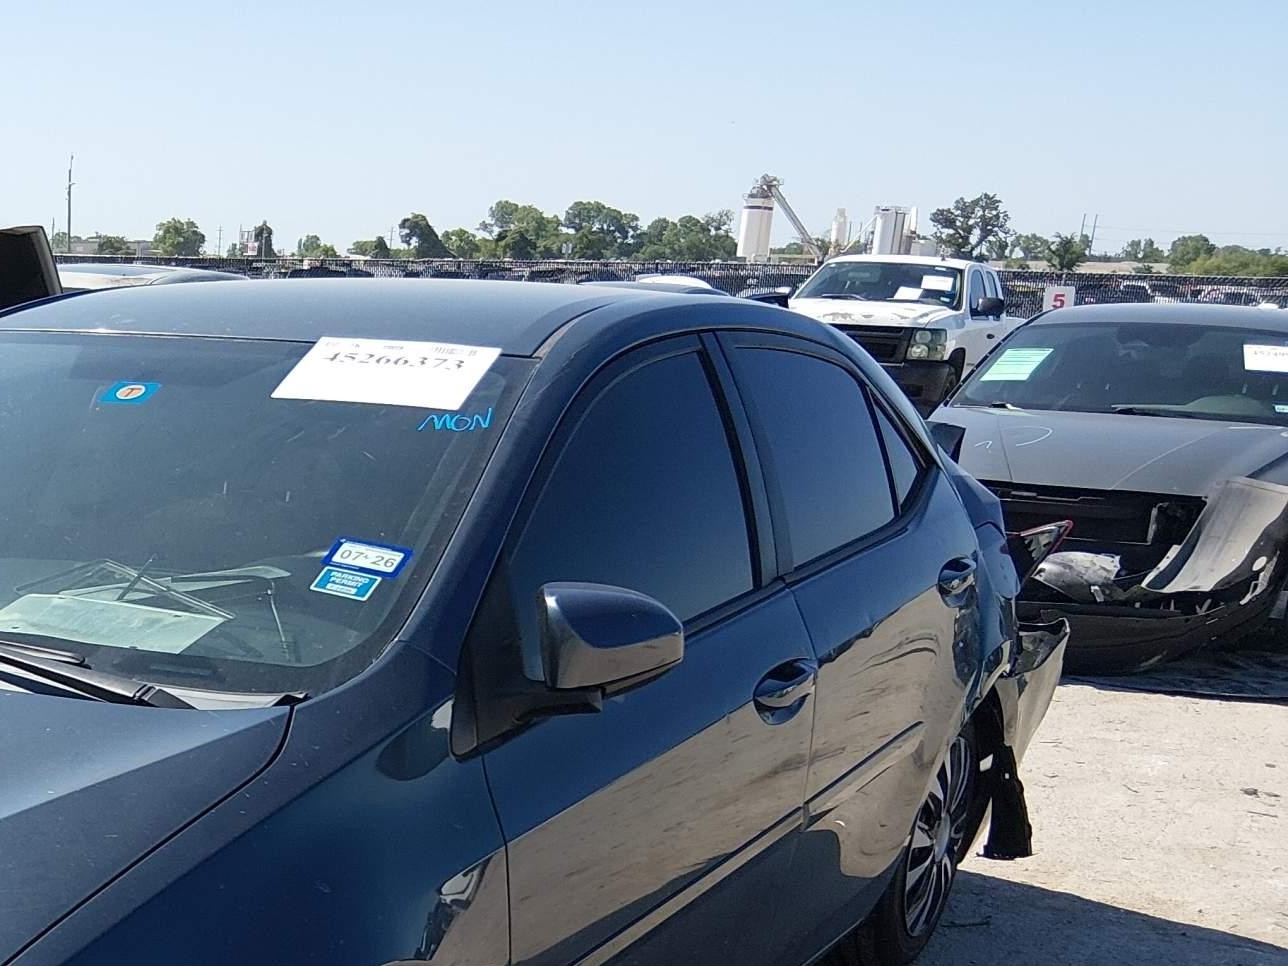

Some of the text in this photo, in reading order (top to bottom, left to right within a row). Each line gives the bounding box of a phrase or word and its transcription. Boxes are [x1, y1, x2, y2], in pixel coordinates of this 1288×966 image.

[1051, 293, 1065, 309] 5
[321, 352, 465, 370] 45266373
[416, 407, 493, 432] MON
